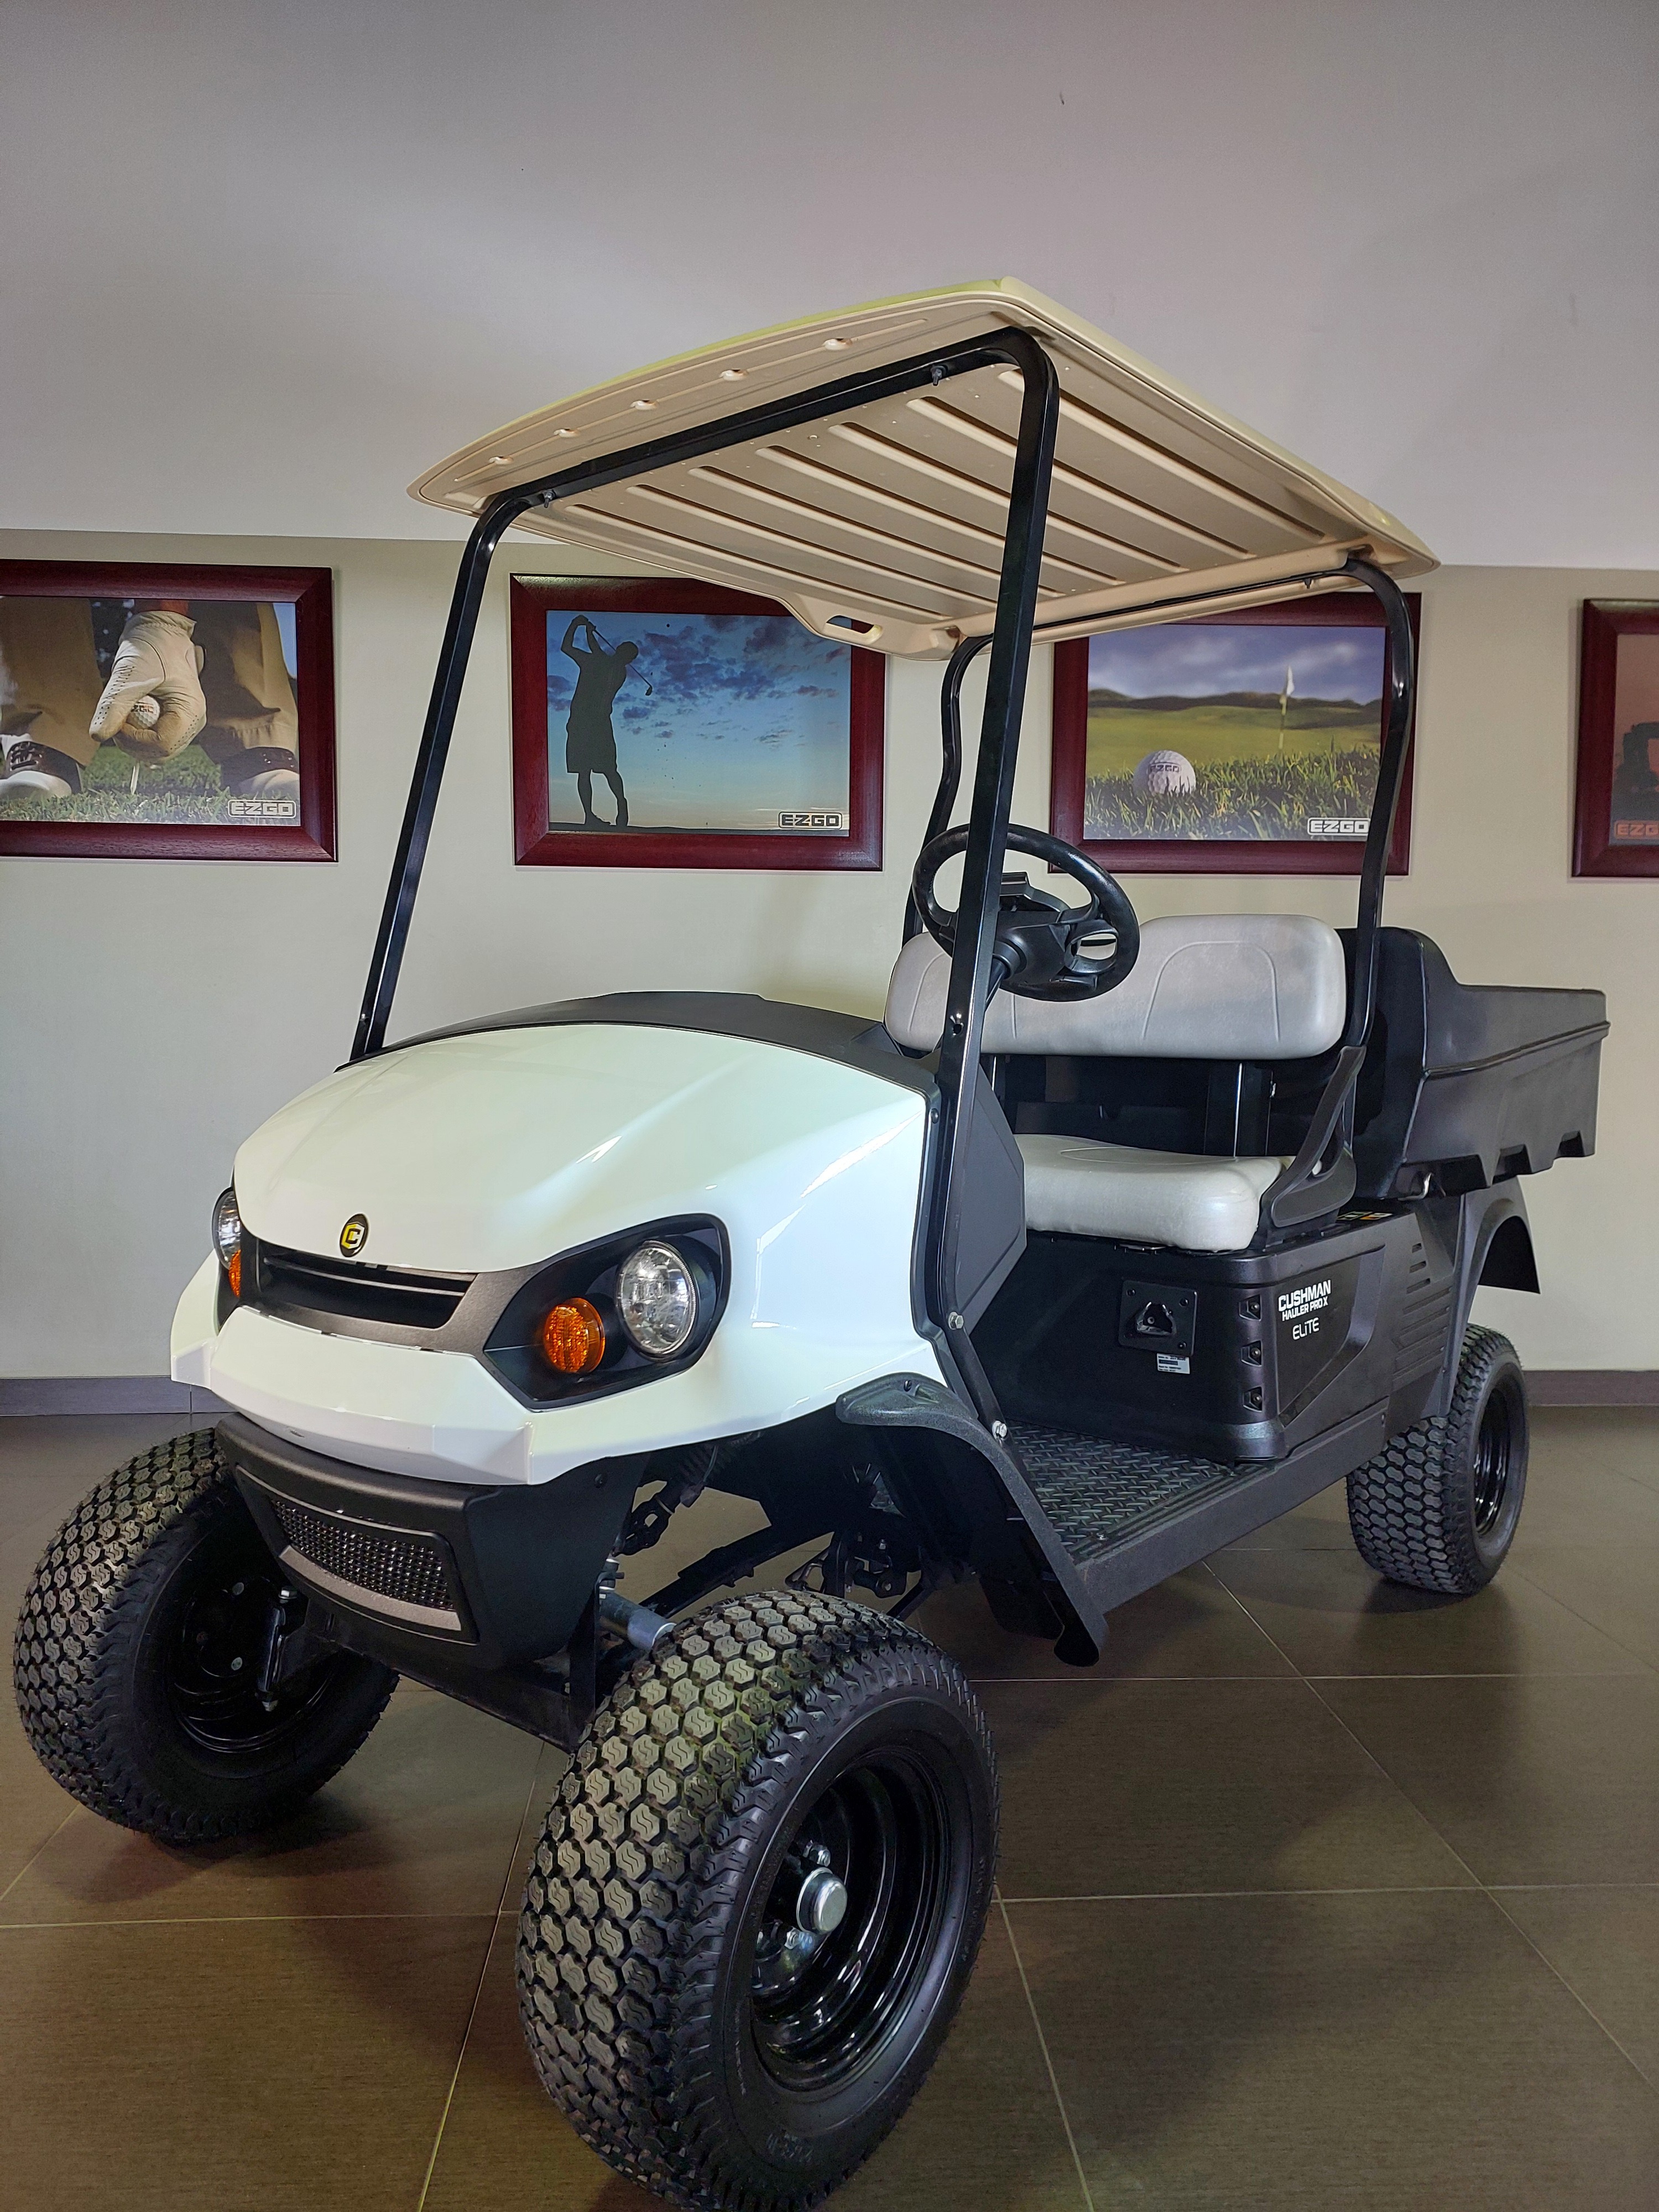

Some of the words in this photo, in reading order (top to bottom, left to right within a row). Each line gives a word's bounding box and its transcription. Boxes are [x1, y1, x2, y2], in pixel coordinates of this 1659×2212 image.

[131, 705, 154, 713] ZGO
[231, 802, 293, 816] EZGO
[781, 815, 839, 827] EZGO
[1311, 821, 1369, 833] EZGO
[1278, 1279, 1331, 1312] CUSHMAN
[1282, 1303, 1309, 1321] HAULER
[1310, 1298, 1323, 1312] PRO
[1323, 1296, 1328, 1307] X
